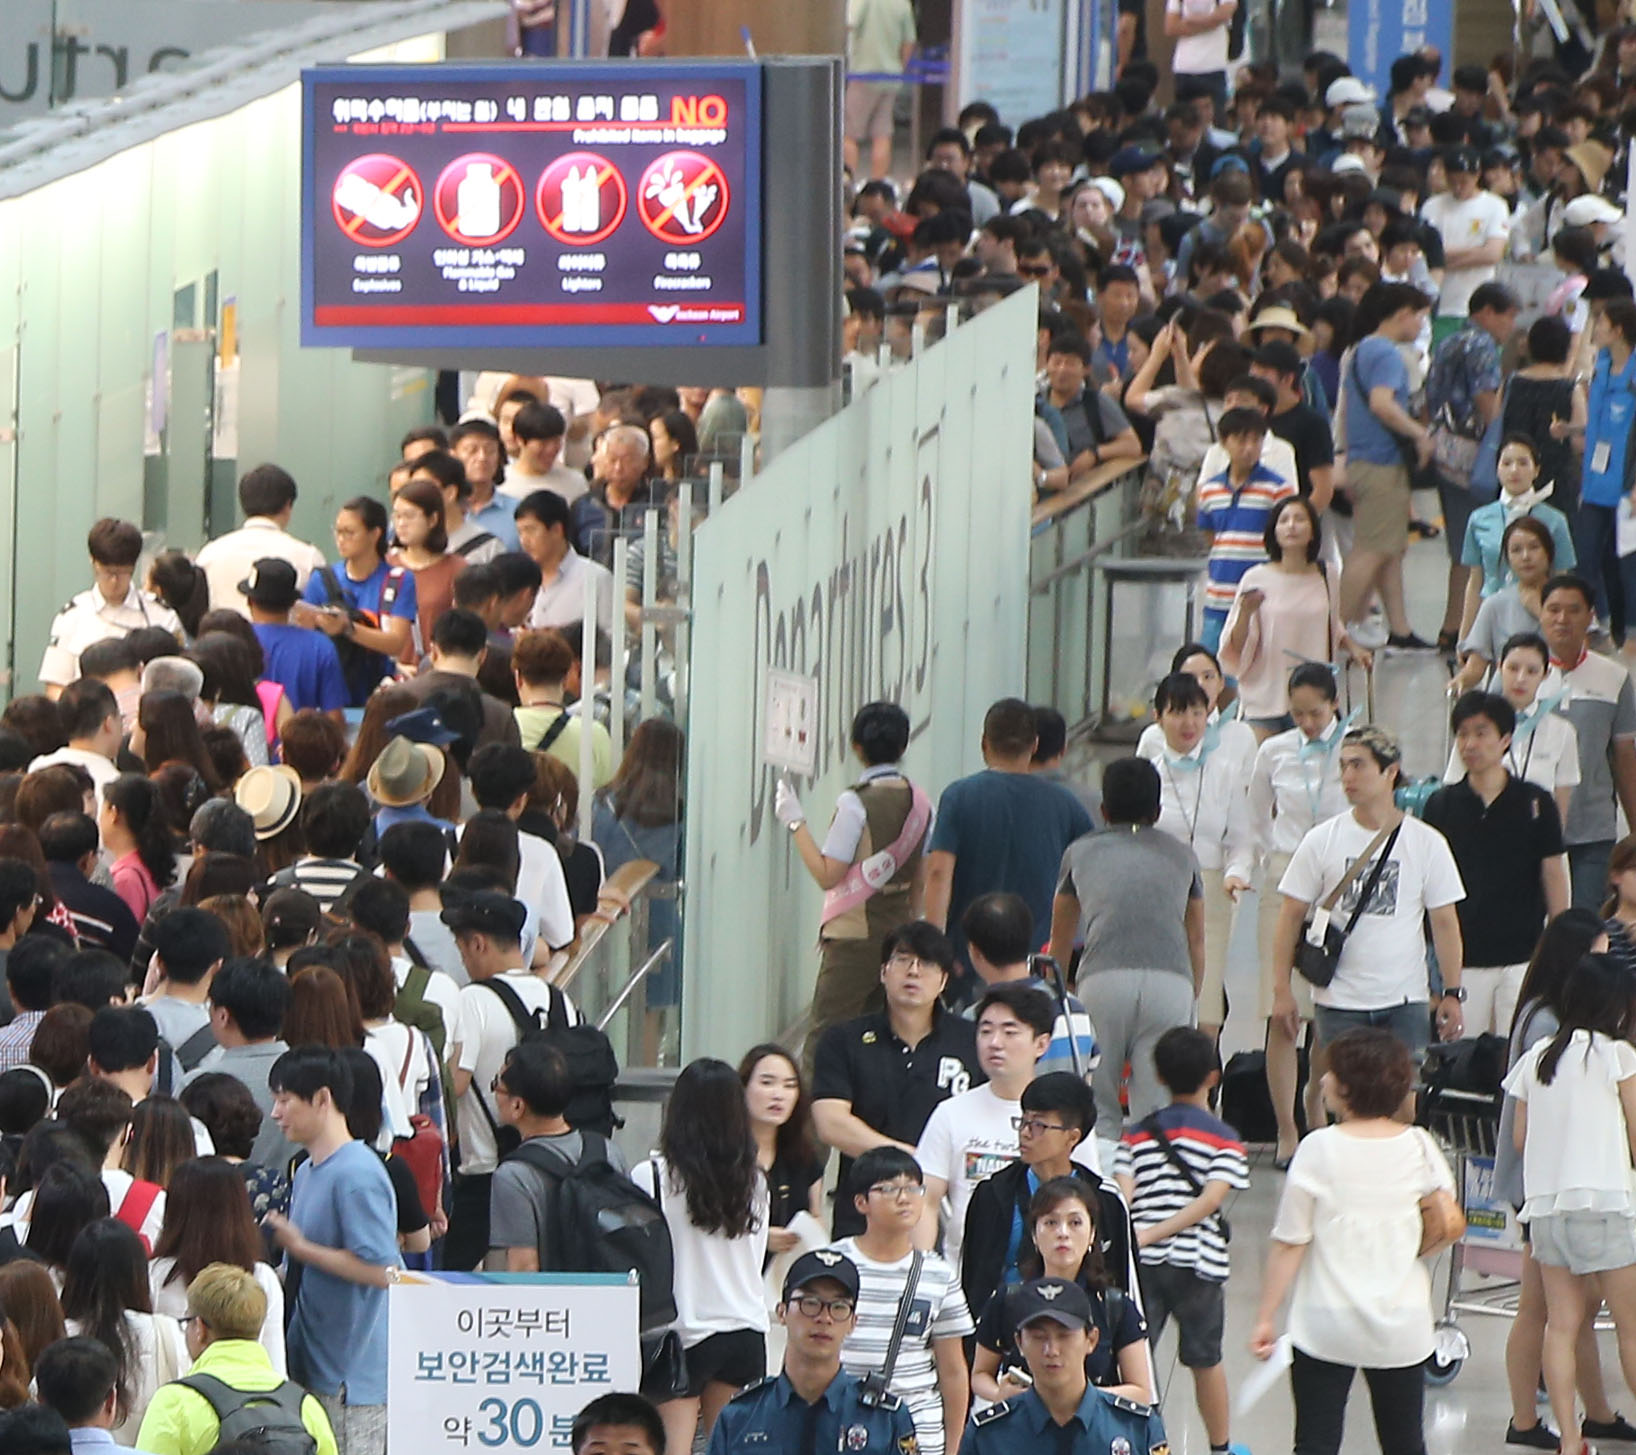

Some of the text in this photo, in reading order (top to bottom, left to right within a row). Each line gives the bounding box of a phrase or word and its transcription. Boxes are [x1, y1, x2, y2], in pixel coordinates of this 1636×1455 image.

[671, 95, 728, 125] NO
[457, 1308, 571, 1339] 이곳부터
[414, 1350, 612, 1385] 보안검색완료
[443, 1416, 472, 1447] 약
[477, 1396, 544, 1448] 30
